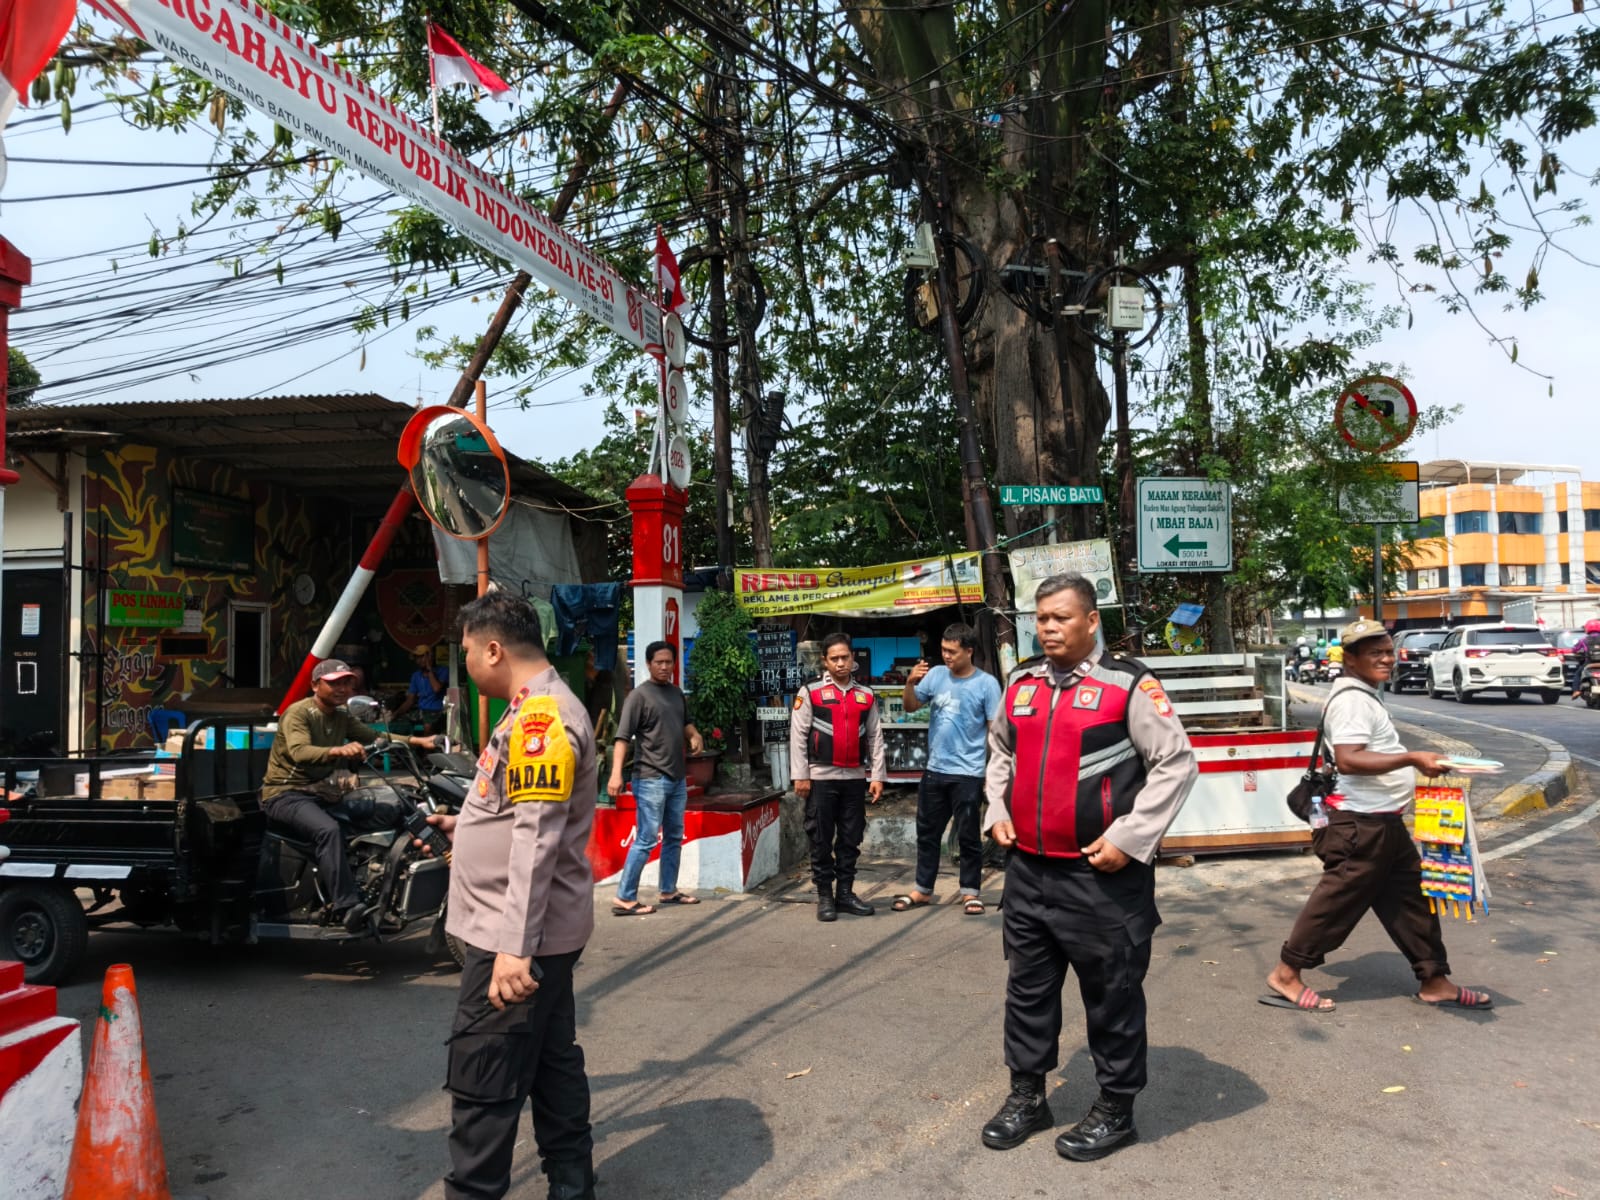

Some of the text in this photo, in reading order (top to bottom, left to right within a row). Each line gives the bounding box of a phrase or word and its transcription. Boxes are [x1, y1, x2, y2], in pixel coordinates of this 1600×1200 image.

[154, 28, 213, 77] WARGA
[214, 67, 265, 108] PISANG
[267, 101, 301, 130] BATU
[343, 93, 471, 208] REPUBLIK
[473, 186, 575, 279] INDONESIA
[576, 257, 615, 304] KE-81
[666, 328, 675, 349] 17
[669, 385, 677, 410] 8
[1002, 486, 1101, 504] JL. PISANG BATU
[1147, 490, 1223, 501] MAKAM KERAMAT
[1156, 517, 1186, 529] MBAH
[1188, 517, 1213, 529] BAJA
[663, 523, 679, 565] 81
[1182, 550, 1195, 558] 500
[741, 573, 819, 593] RENO
[112, 592, 183, 610] POS LINMAS
[743, 594, 791, 604] REKLAME
[793, 594, 799, 602] &
[664, 610, 676, 636] 17
[1183, 643, 1193, 653] 6
[508, 763, 561, 795] PADAL
